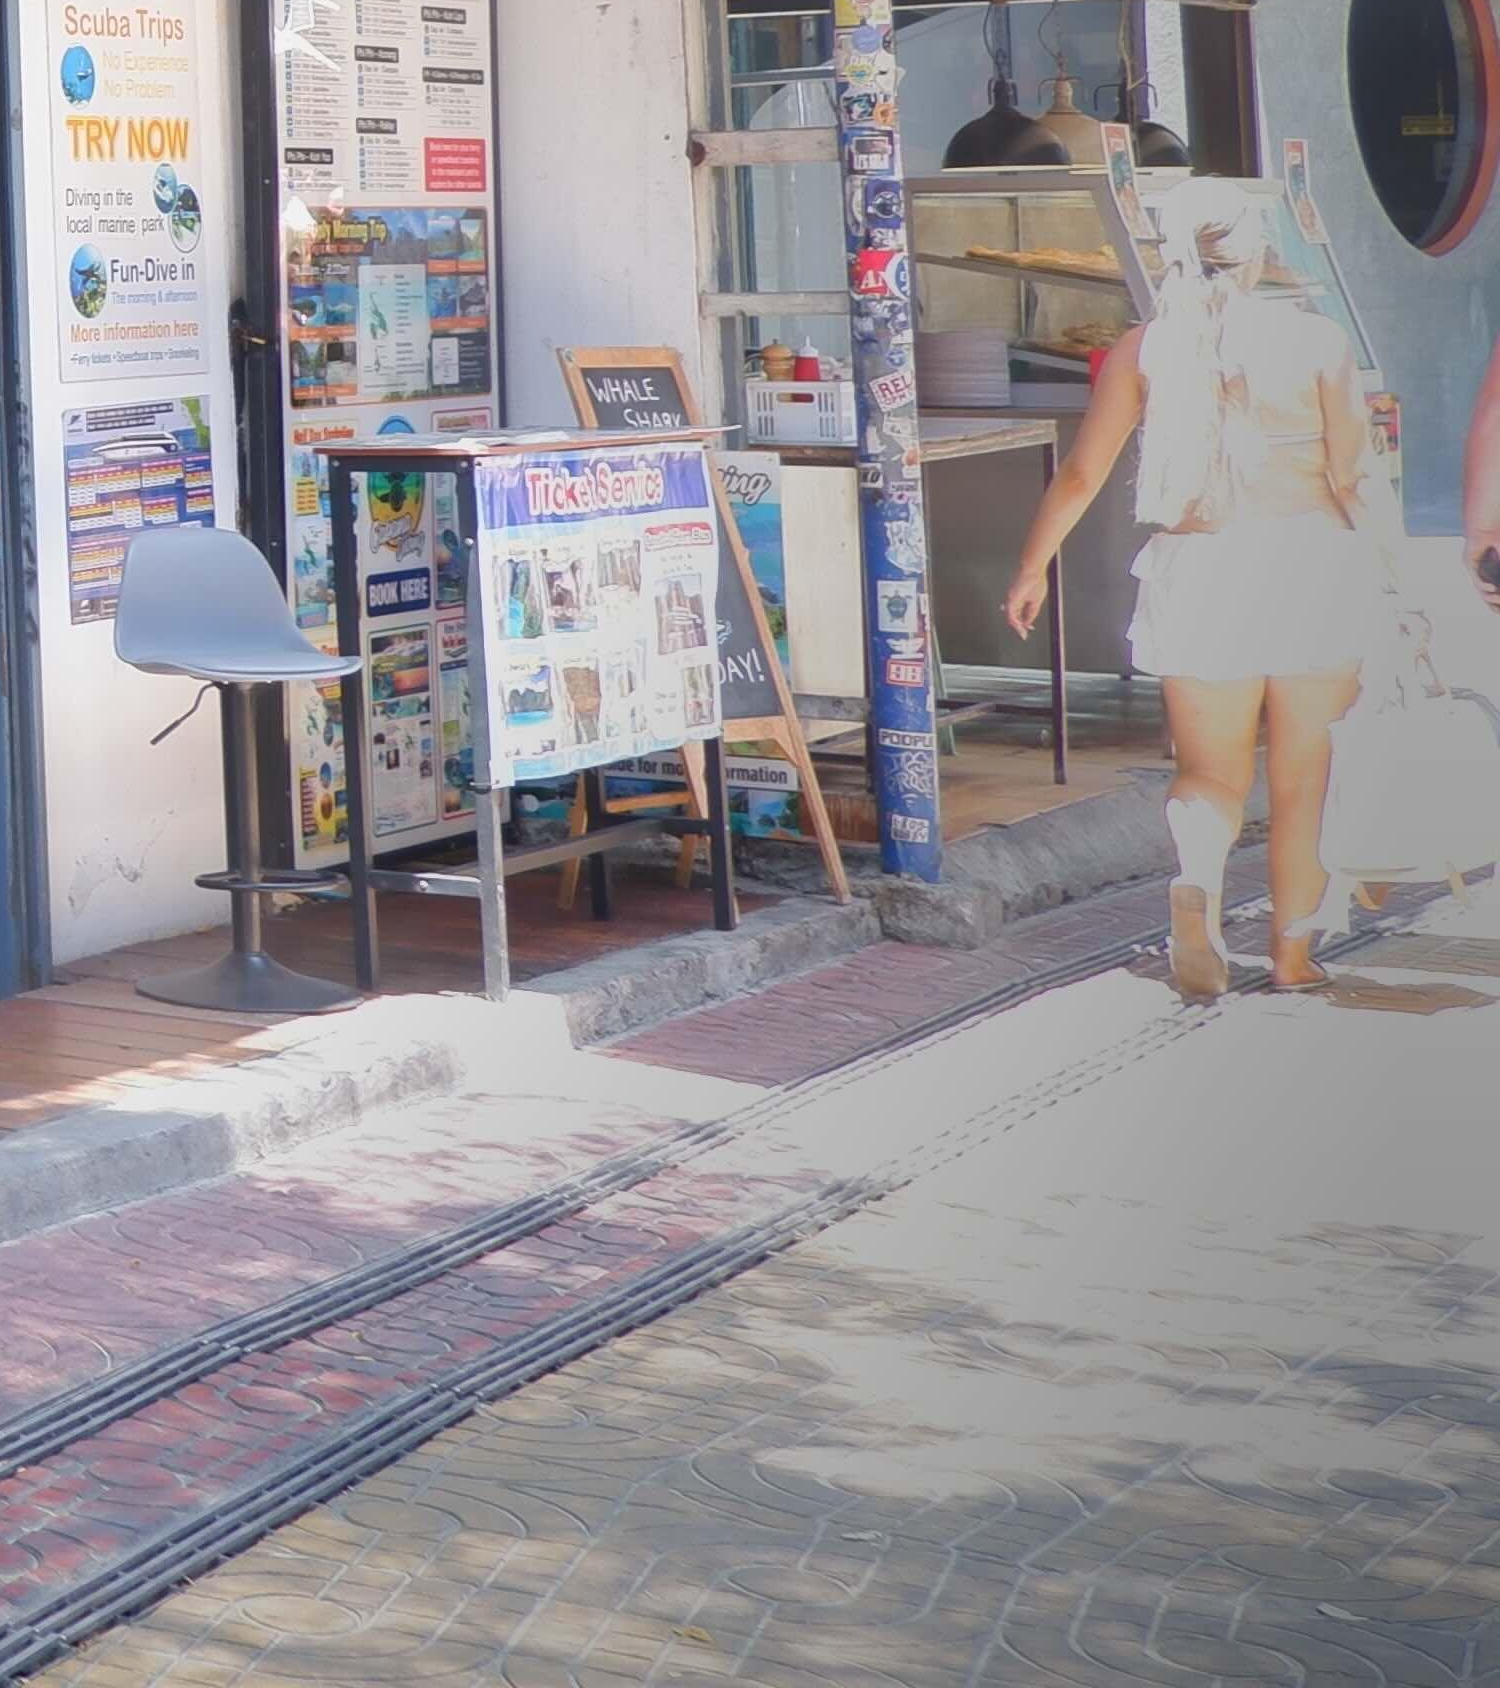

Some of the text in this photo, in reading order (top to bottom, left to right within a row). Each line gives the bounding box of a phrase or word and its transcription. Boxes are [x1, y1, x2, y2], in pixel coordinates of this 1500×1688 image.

[64, 5, 184, 46] Scuba Trips
[66, 117, 189, 159] TRY NOW
[66, 188, 133, 210] Diving in the
[66, 214, 164, 236] local marine park
[110, 258, 195, 283] Fun-Dive in
[71, 320, 198, 342] More information here
[588, 378, 659, 404] WHALE
[526, 466, 592, 515] Ticket
[369, 577, 429, 607] BOOK HERE
